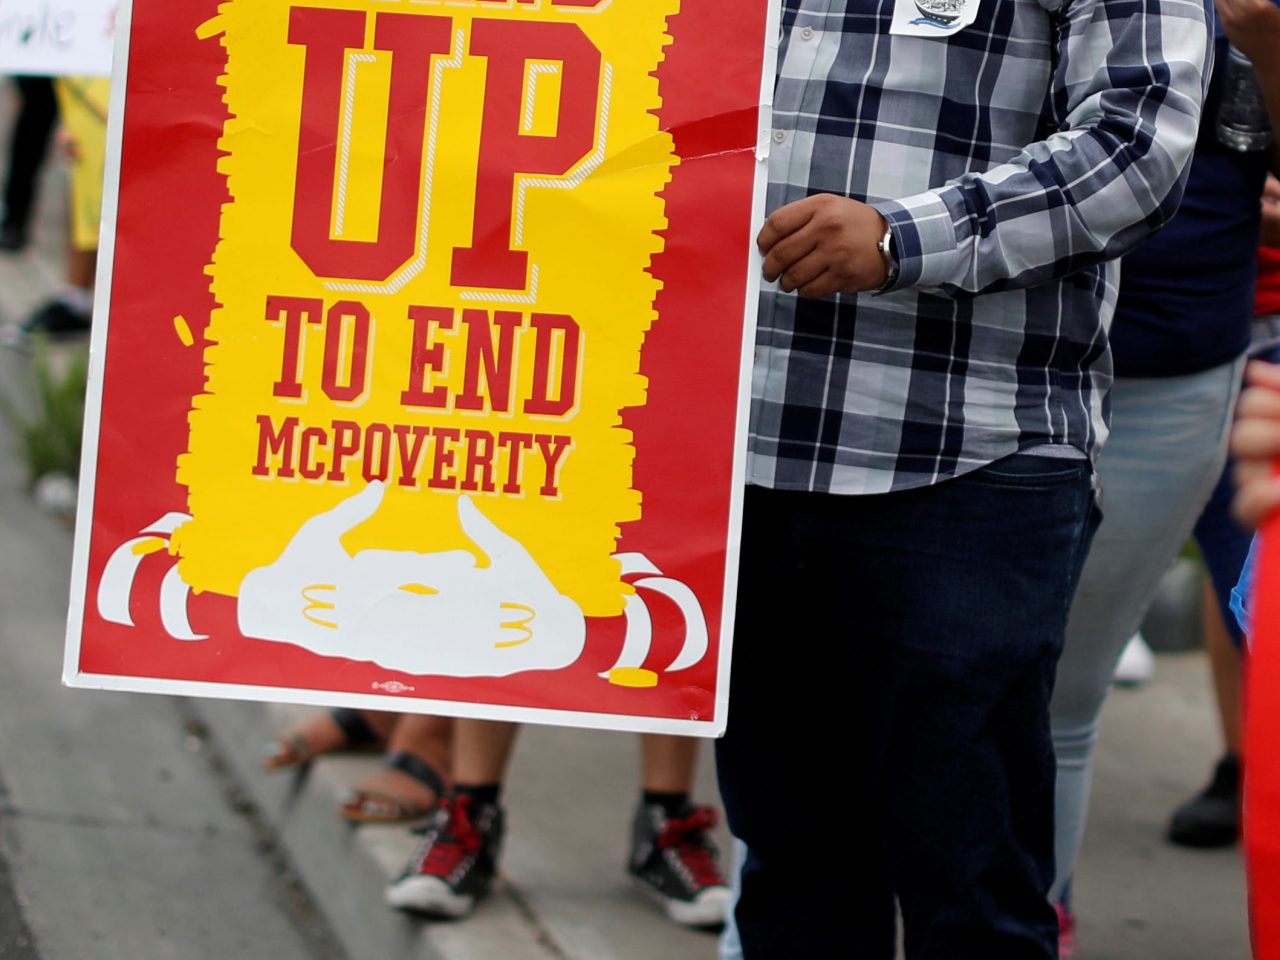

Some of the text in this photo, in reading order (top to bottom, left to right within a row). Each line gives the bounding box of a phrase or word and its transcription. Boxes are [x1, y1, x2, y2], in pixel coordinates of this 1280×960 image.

[287, 5, 613, 304] UP
[265, 295, 586, 422] TO END
